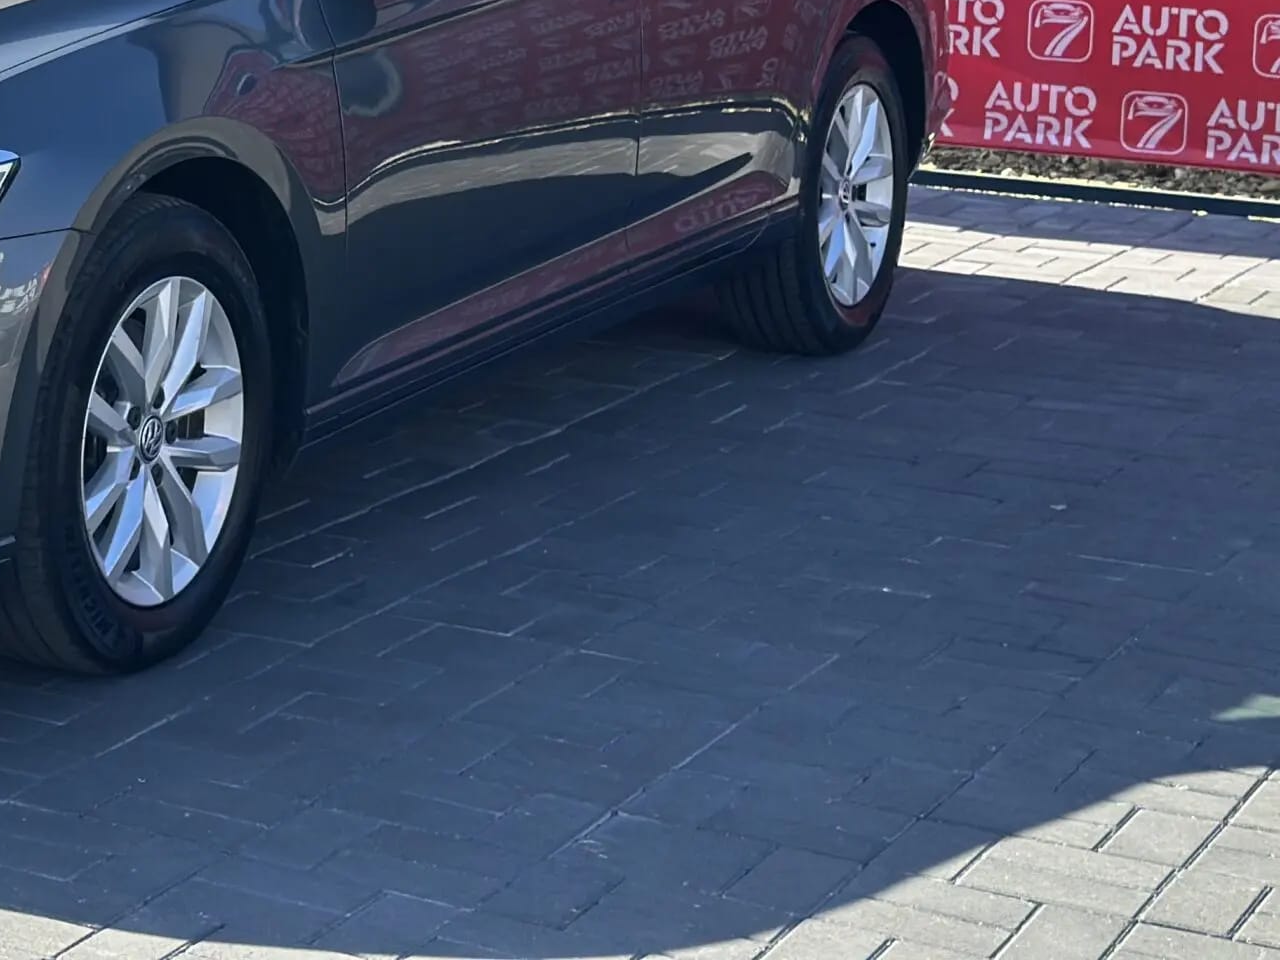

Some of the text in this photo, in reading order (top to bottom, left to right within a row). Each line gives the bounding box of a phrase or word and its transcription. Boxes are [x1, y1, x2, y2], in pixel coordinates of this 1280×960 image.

[1111, 3, 1229, 41] AUTO
[1111, 34, 1224, 74] PARK
[984, 79, 1098, 117] AUTO
[982, 111, 1094, 149] PARK
